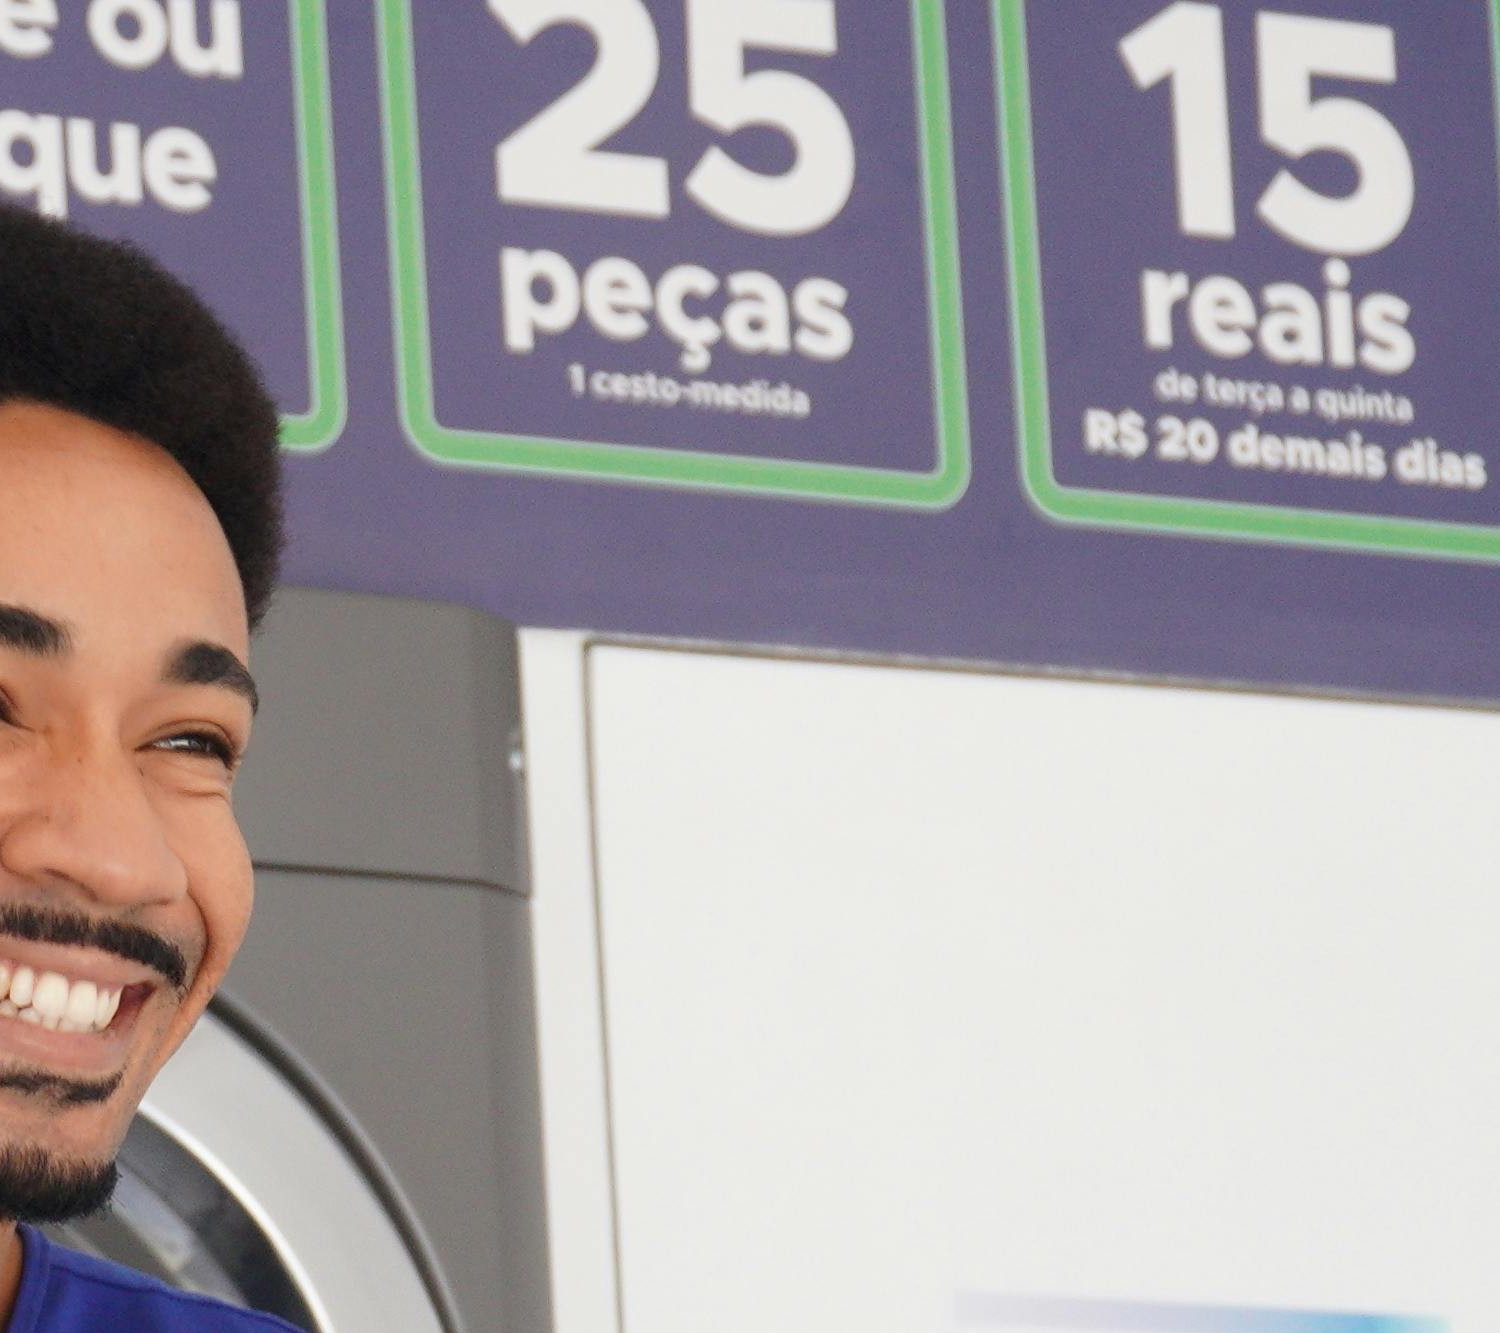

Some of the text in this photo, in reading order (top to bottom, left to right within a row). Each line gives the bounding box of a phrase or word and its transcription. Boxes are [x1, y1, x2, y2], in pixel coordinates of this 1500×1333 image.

[86, 0, 244, 81] ou
[484, 0, 857, 238] 25
[1116, 0, 1415, 257] 15
[499, 244, 856, 374] peças
[1140, 256, 1417, 377] reais
[566, 361, 812, 421] 1 cesto-medida
[1154, 366, 1415, 426] de terça a quinta
[1083, 407, 1488, 490] R$ 20 demais dias
